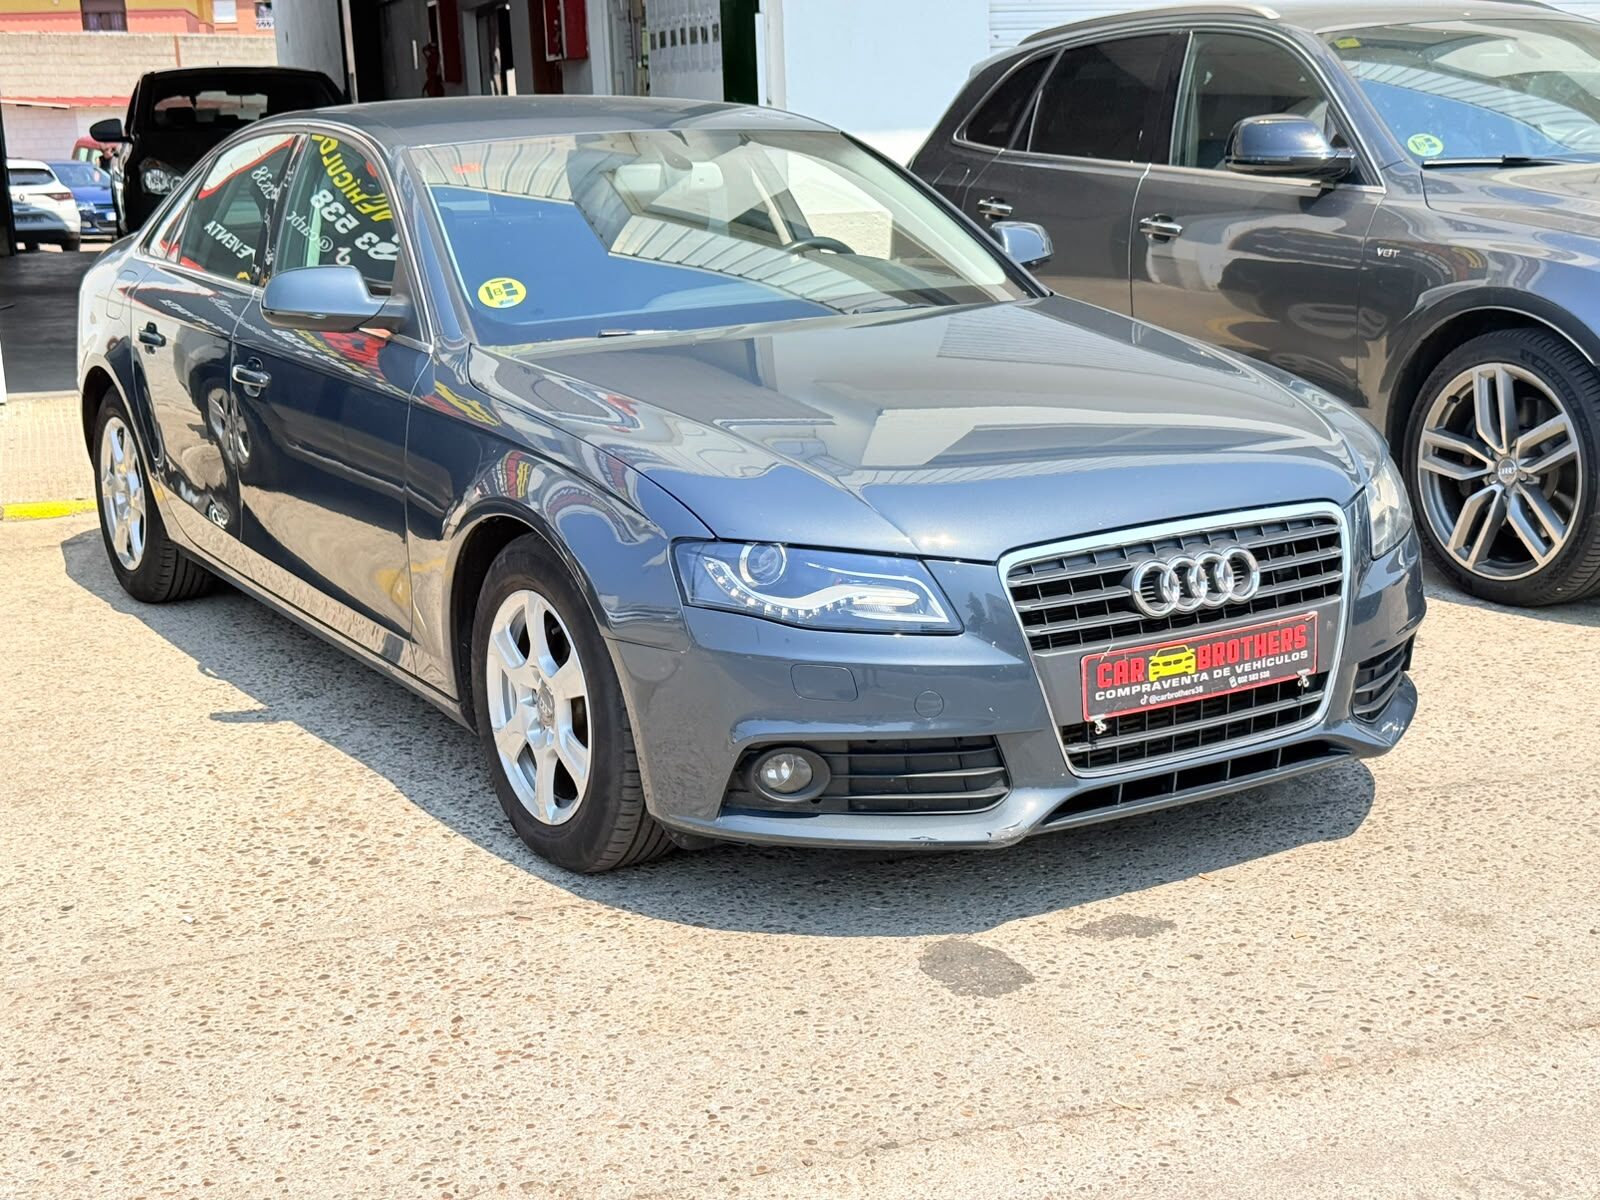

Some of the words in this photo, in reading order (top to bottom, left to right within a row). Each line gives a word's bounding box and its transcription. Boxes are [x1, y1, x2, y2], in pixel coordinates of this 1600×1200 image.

[1094, 672, 1210, 701] COMPRAVENTA
[1212, 667, 1231, 679] DE
[1235, 650, 1309, 674] VEHÍCULOS
[1097, 657, 1146, 689] CAR
[1197, 624, 1307, 671] BROTHERS
